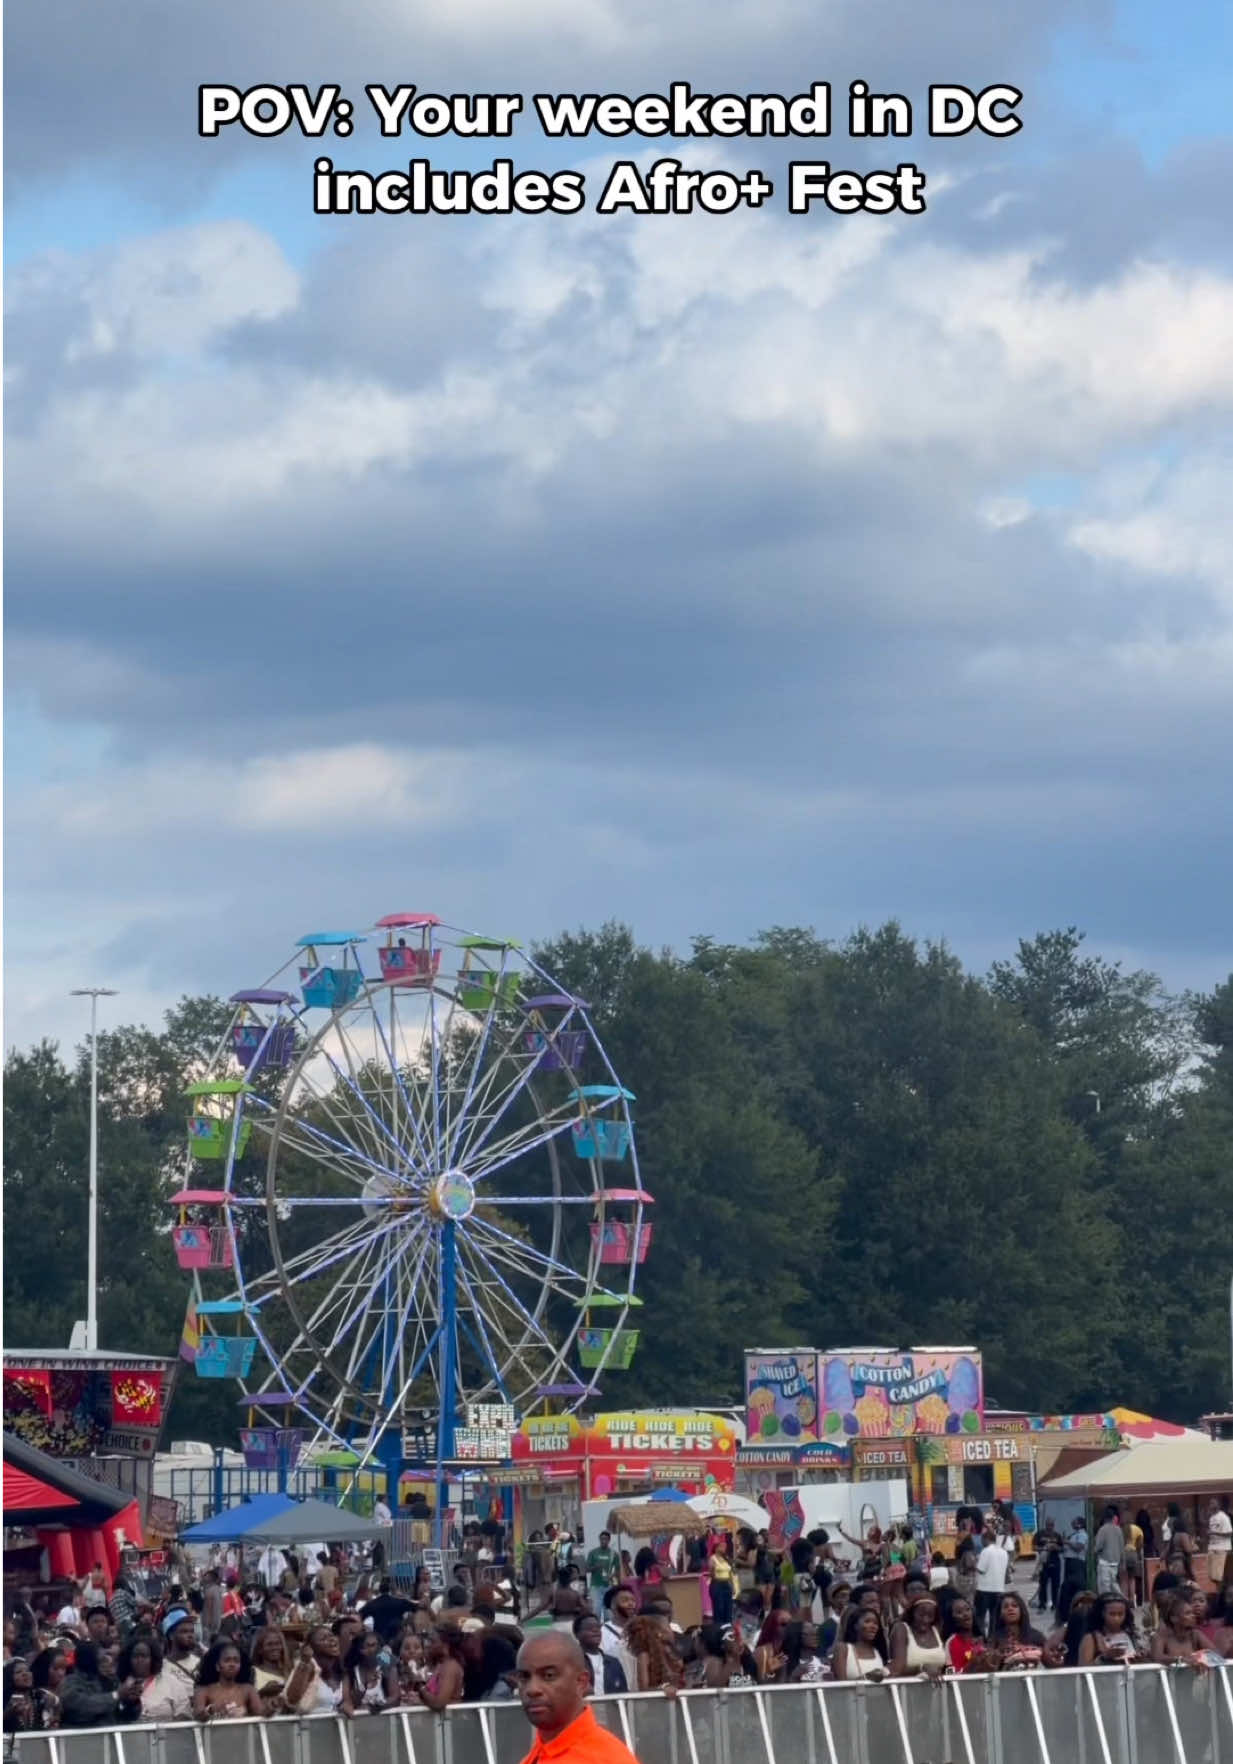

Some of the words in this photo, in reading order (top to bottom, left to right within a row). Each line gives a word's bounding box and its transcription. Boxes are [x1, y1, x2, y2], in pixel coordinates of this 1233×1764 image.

[858, 1364, 912, 1382] COTTON
[783, 1380, 801, 1396] ICE
[888, 1376, 938, 1402] CANDY
[607, 1420, 637, 1432] RIDE
[105, 1434, 140, 1449] CHOICE
[528, 1435, 569, 1452] TICKETS
[607, 1433, 713, 1451] TICKETS
[962, 1440, 990, 1460] ICED
[994, 1439, 1018, 1459] TEA
[863, 1452, 886, 1464] ICED
[889, 1452, 907, 1463] TEA
